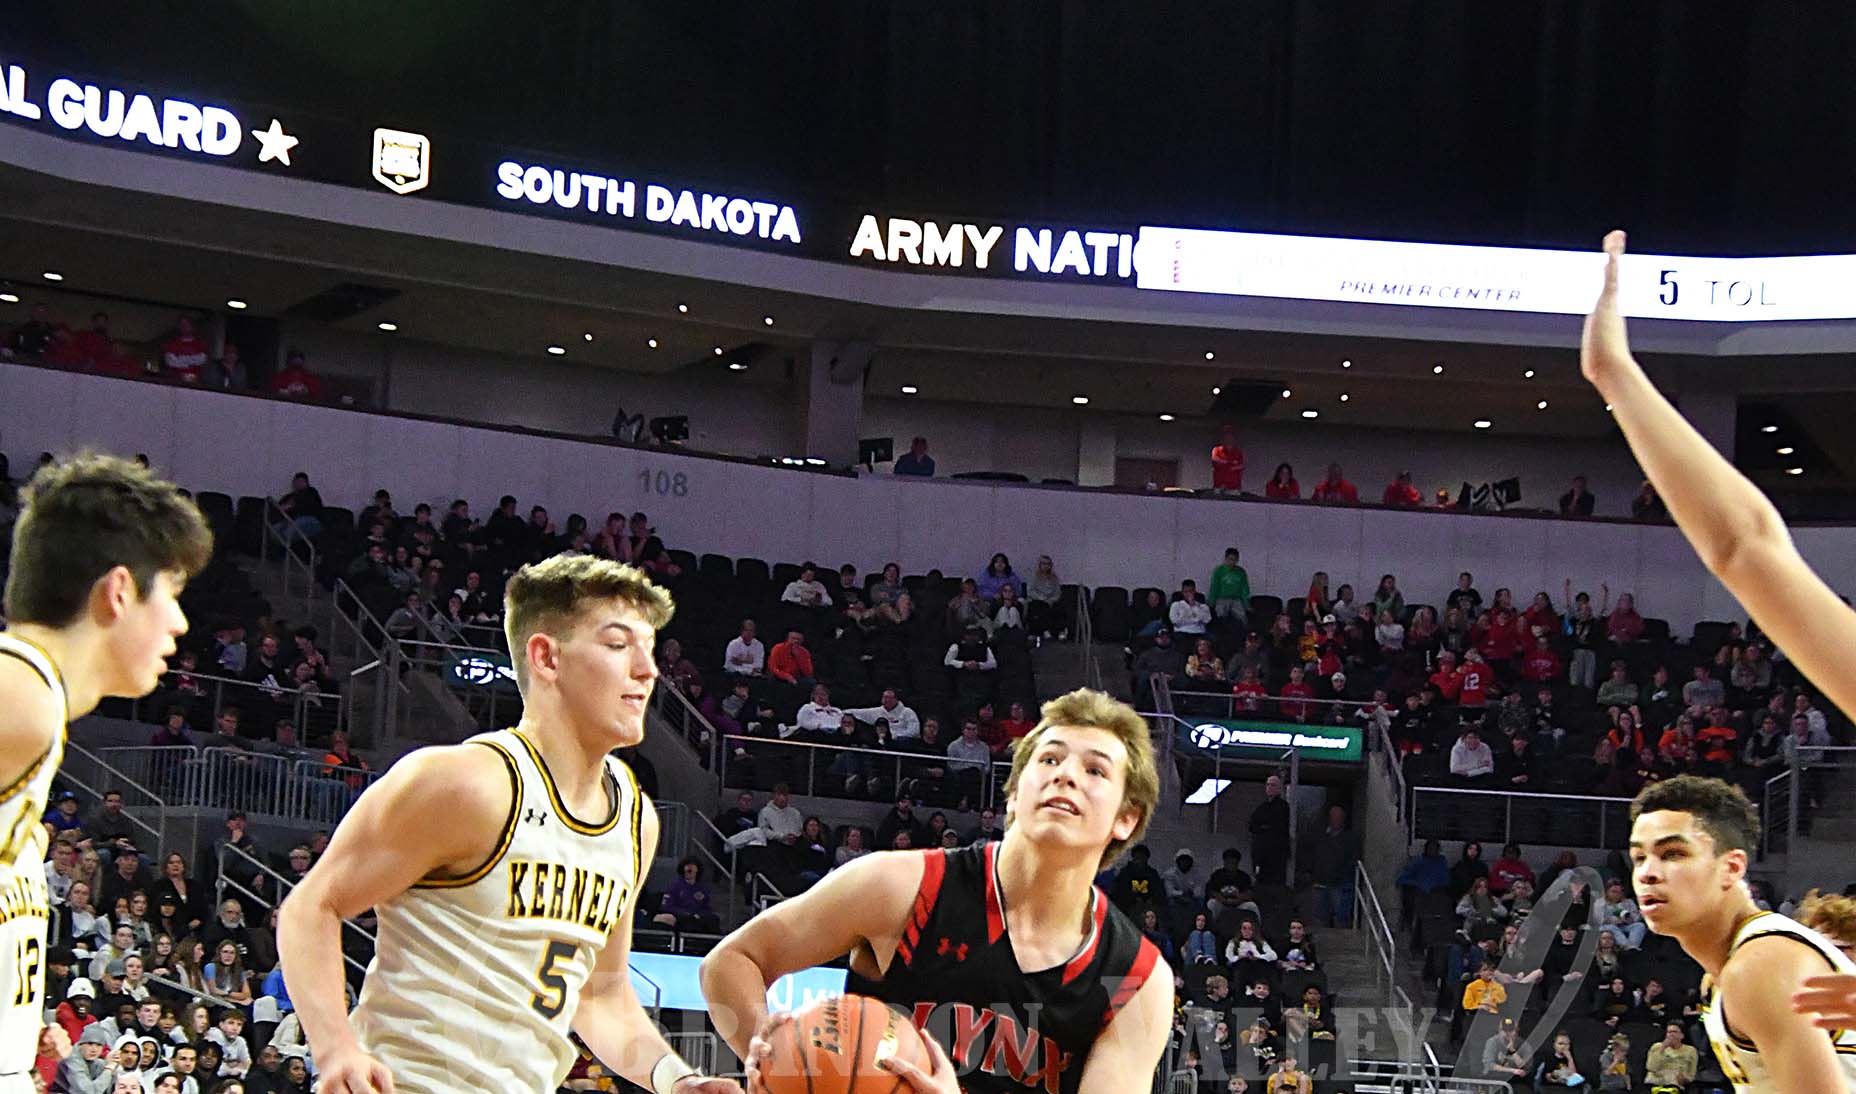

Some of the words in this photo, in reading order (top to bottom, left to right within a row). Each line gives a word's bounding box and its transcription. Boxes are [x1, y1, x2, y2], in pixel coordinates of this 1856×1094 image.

[0, 65, 41, 120] L
[48, 78, 242, 156] GUARD
[497, 161, 635, 217] SOUTH
[645, 184, 801, 244] DAKOTA
[850, 214, 1003, 269] ARMY
[1014, 227, 1141, 278] NATI
[1340, 280, 1431, 297] PREMIER
[1438, 286, 1521, 301] CENTER
[1659, 270, 1679, 306] 5
[1704, 280, 1777, 306] TOL
[640, 469, 688, 497] 108
[14, 937, 40, 1008] 12
[529, 938, 580, 1020] 5
